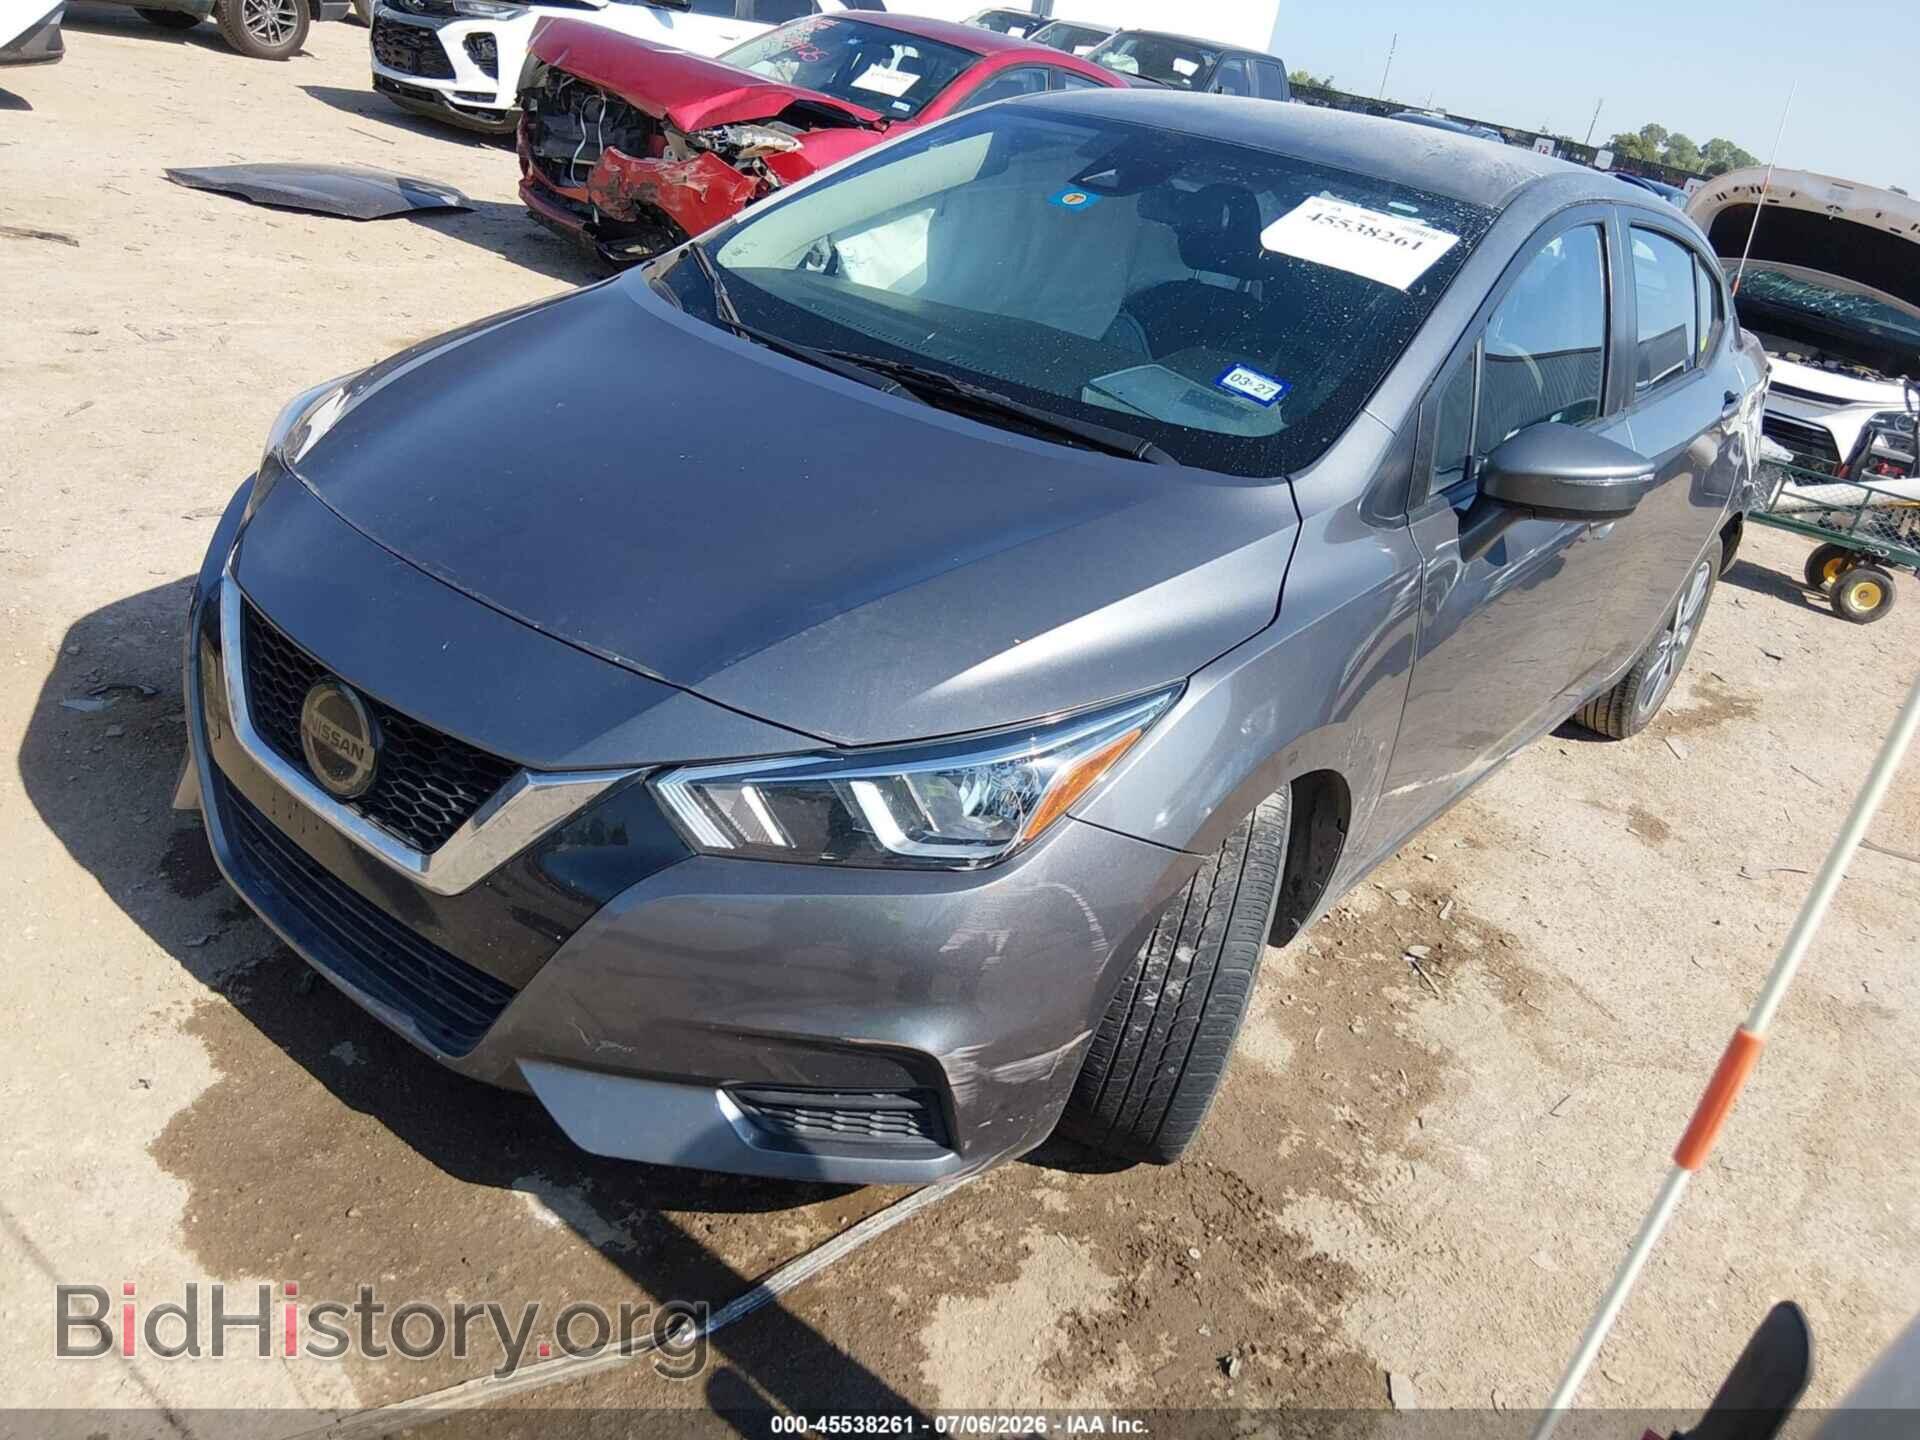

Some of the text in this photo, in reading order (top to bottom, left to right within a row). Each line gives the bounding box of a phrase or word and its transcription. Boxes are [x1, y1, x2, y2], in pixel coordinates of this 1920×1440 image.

[1537, 144, 1549, 154] 12
[1306, 212, 1424, 251] 45538261
[303, 712, 364, 761] NISSAN
